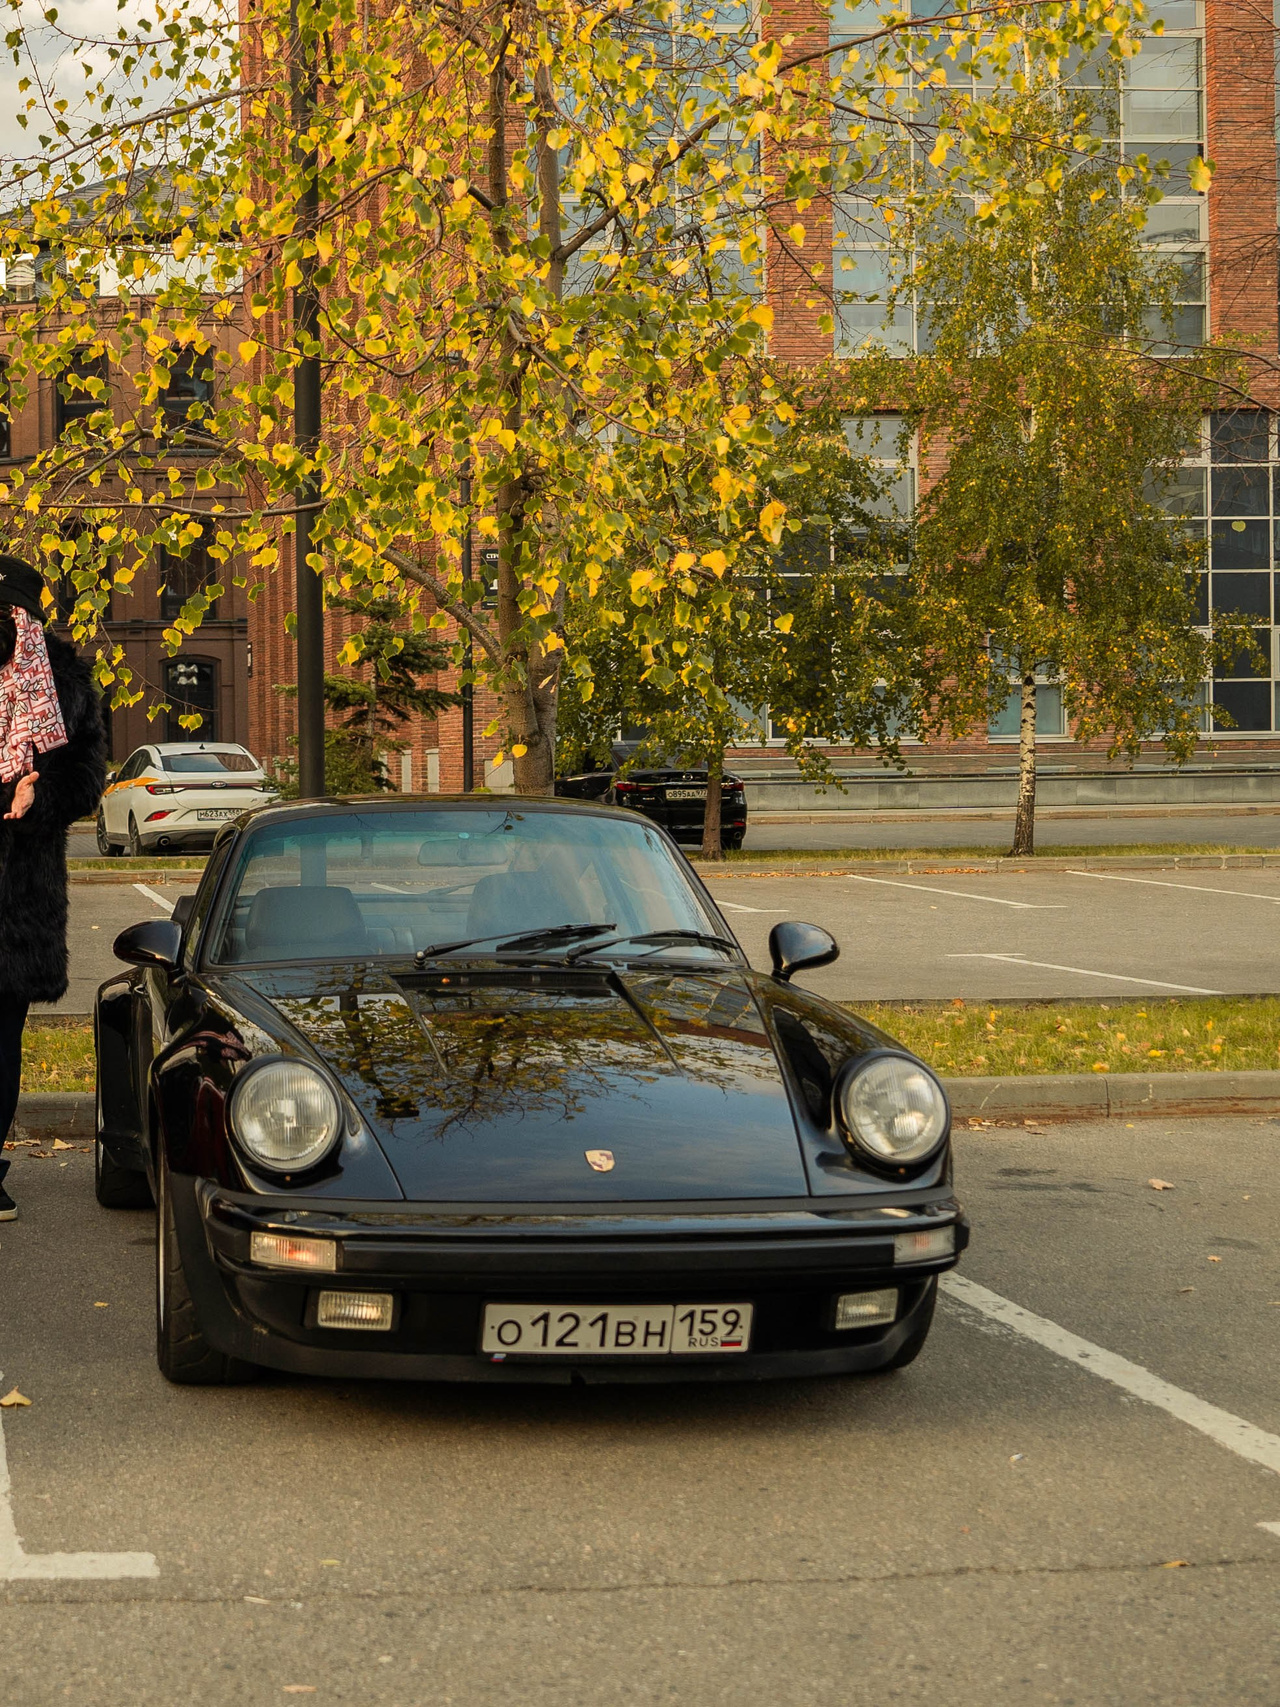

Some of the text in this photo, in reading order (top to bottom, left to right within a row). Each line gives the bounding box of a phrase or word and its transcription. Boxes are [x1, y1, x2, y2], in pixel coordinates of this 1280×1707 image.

[497, 1308, 742, 1348] О121ВН 159
[688, 1336, 719, 1347] RUS
